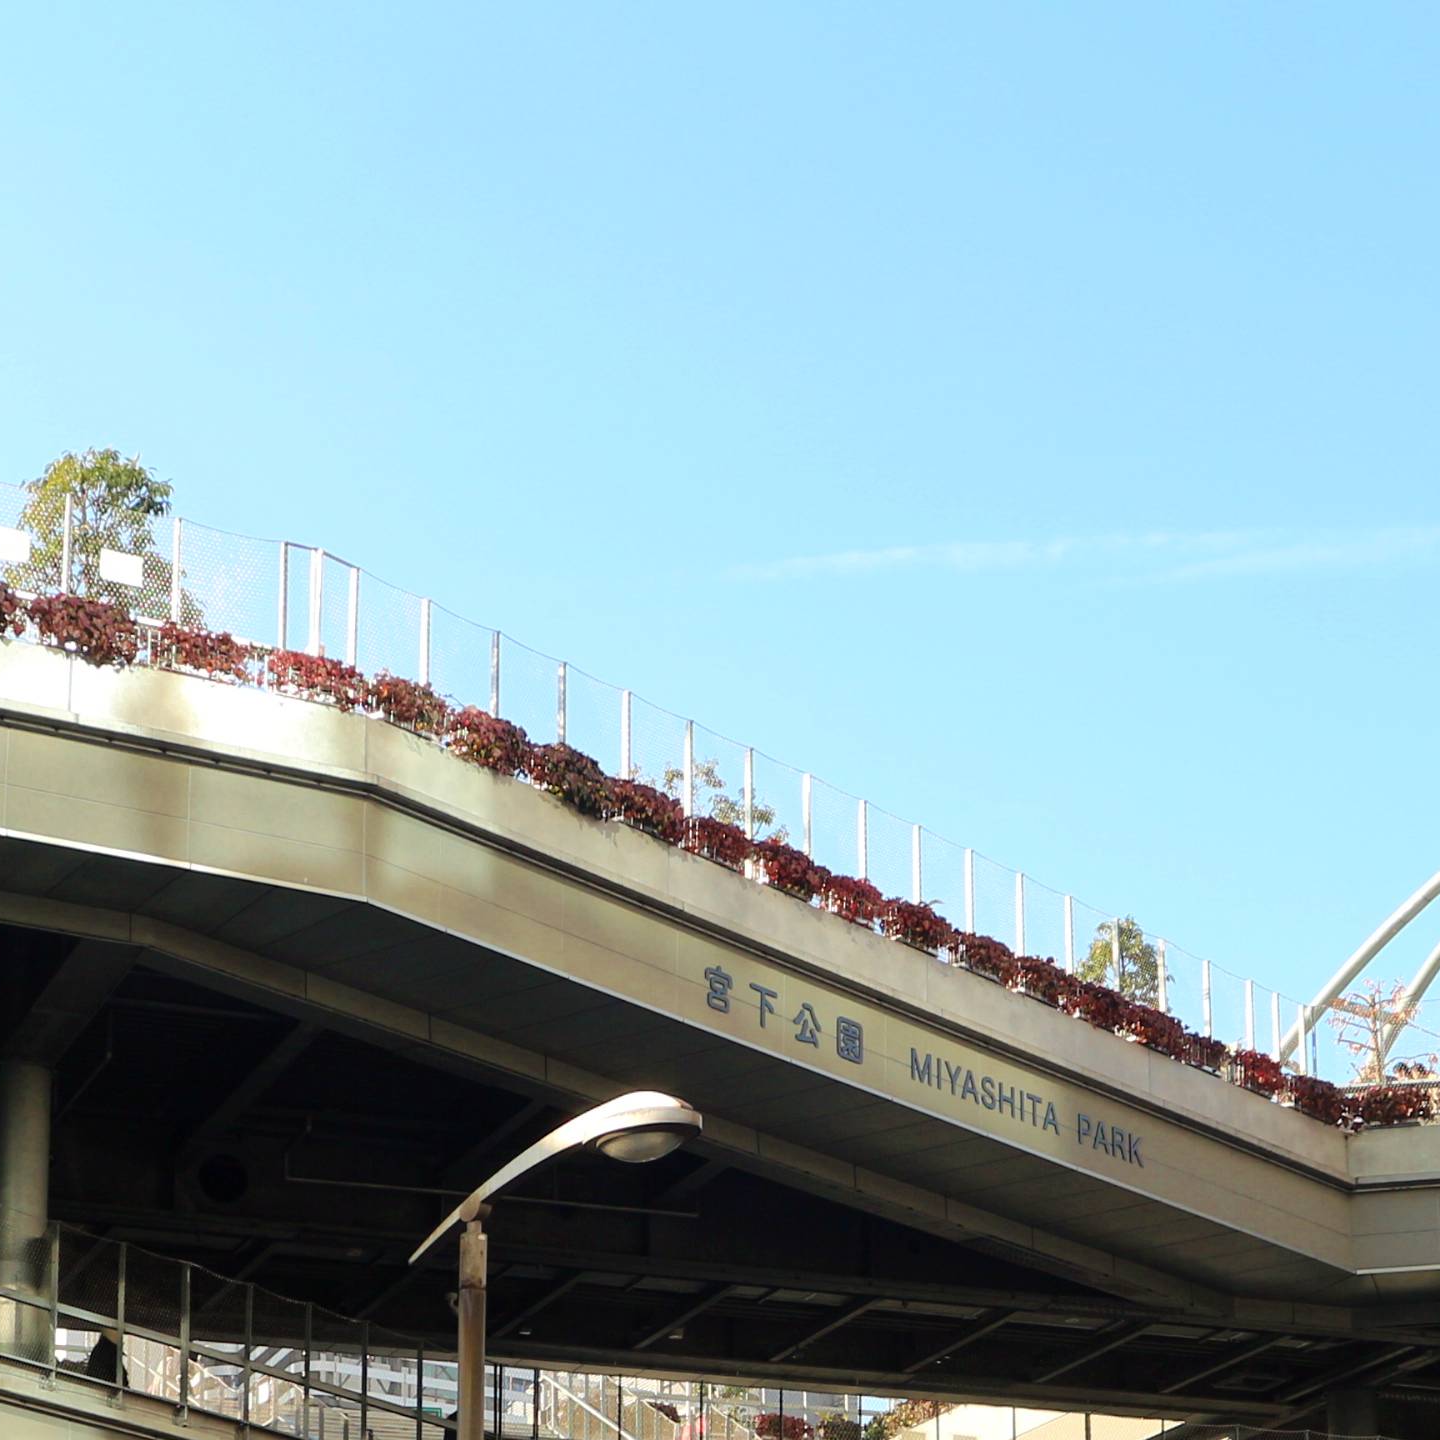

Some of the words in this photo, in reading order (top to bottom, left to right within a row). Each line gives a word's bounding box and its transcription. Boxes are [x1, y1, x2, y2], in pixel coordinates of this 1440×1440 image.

[702, 965, 864, 1065] 宮下公園
[909, 1046, 1061, 1137] MIYASHITA
[1076, 1111, 1145, 1168] PARK
